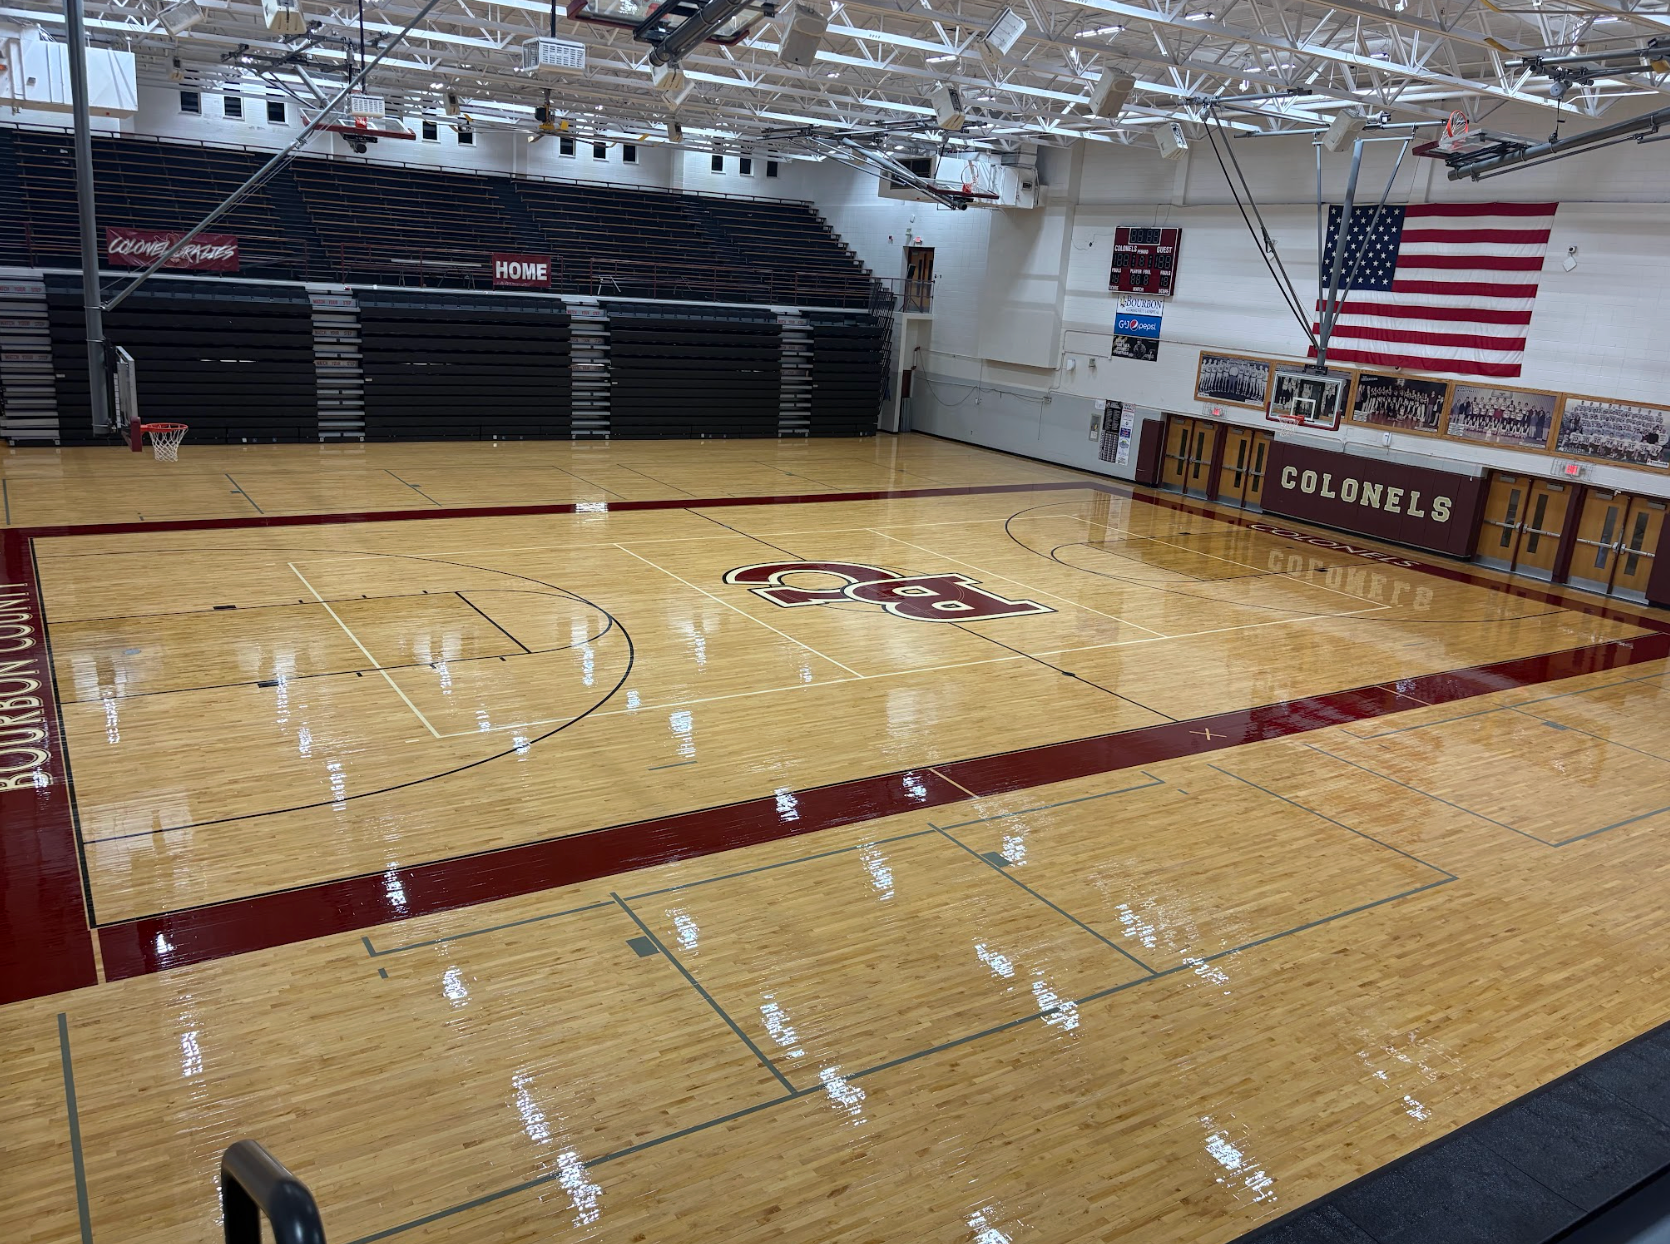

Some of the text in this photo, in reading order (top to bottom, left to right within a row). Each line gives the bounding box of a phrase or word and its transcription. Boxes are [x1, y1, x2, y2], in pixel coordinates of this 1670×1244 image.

[108, 236, 170, 257] COLONEL
[1114, 244, 1138, 252] COLONELS
[496, 260, 548, 280] HOME
[1125, 296, 1162, 309] BOURBON
[1118, 320, 1156, 331] G&J pepsi
[1281, 466, 1452, 522] COLONELS
[1251, 524, 1421, 567] COLONELS
[0, 658, 54, 792] BOURBON
